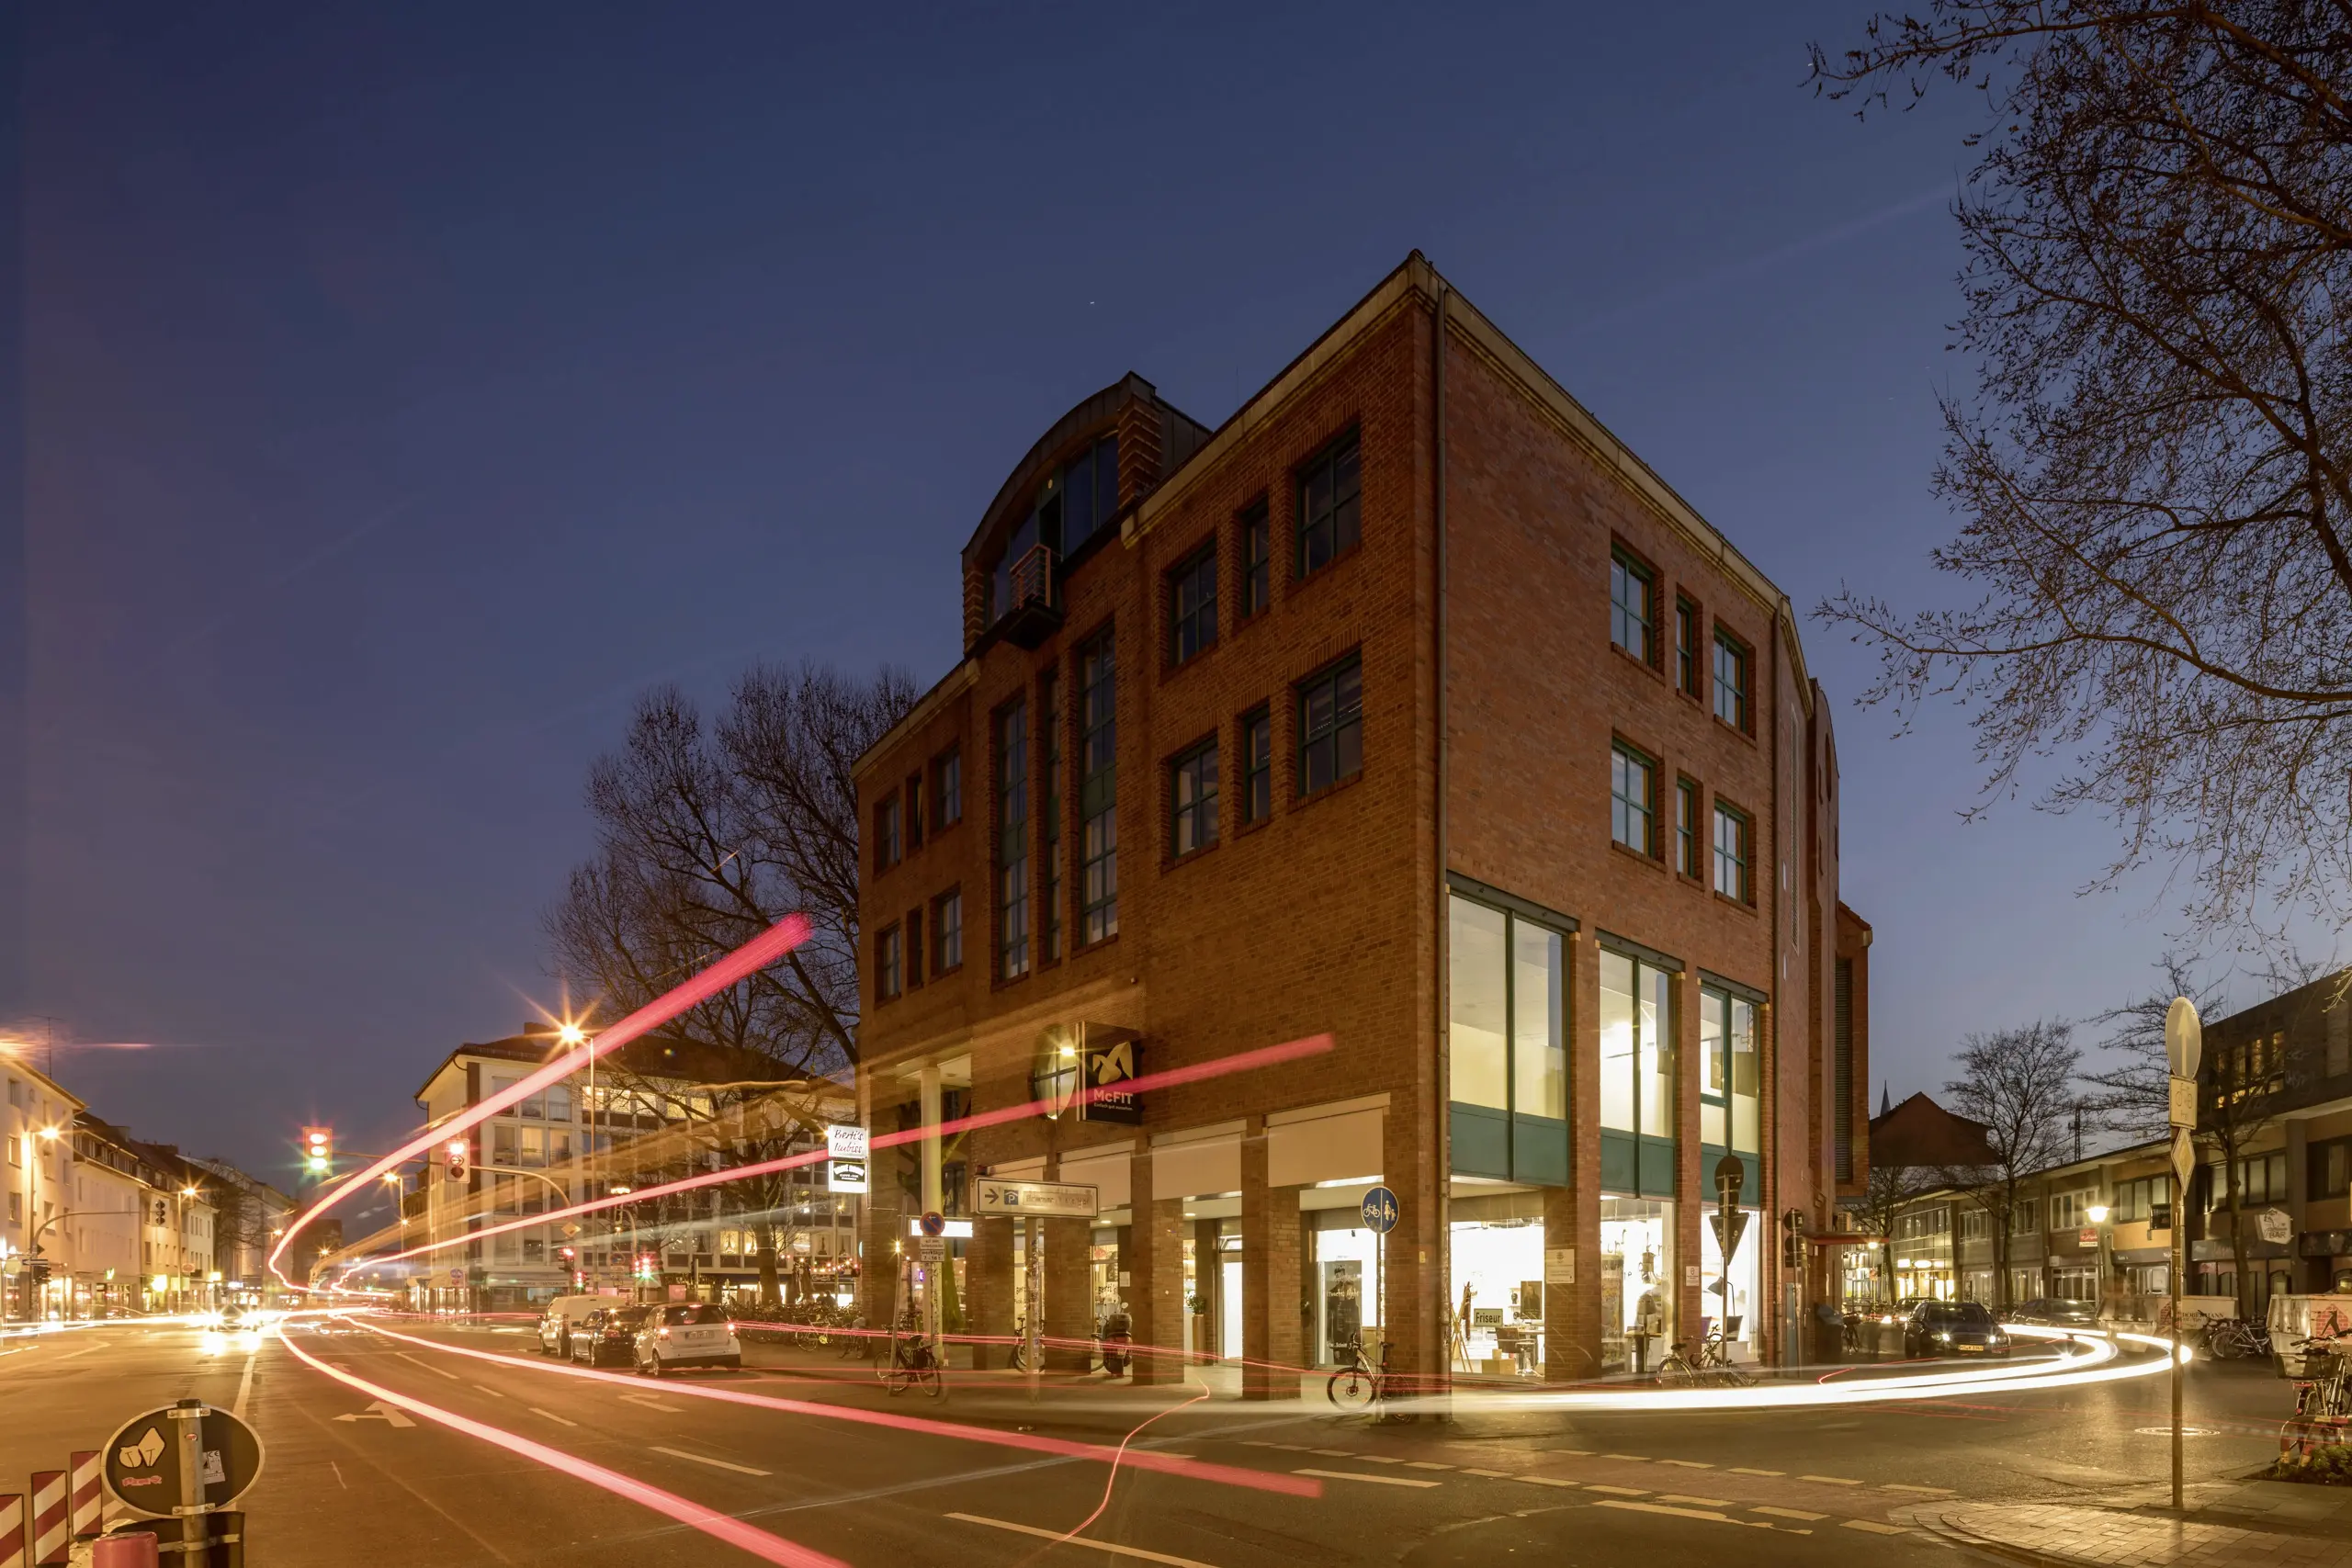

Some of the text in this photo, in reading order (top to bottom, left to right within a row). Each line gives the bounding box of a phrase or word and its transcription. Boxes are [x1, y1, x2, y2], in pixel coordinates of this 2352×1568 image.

[1093, 1089, 1134, 1104] McFIT
[834, 1129, 864, 1141] Berti's
[1476, 1312, 1501, 1324] Friseur
